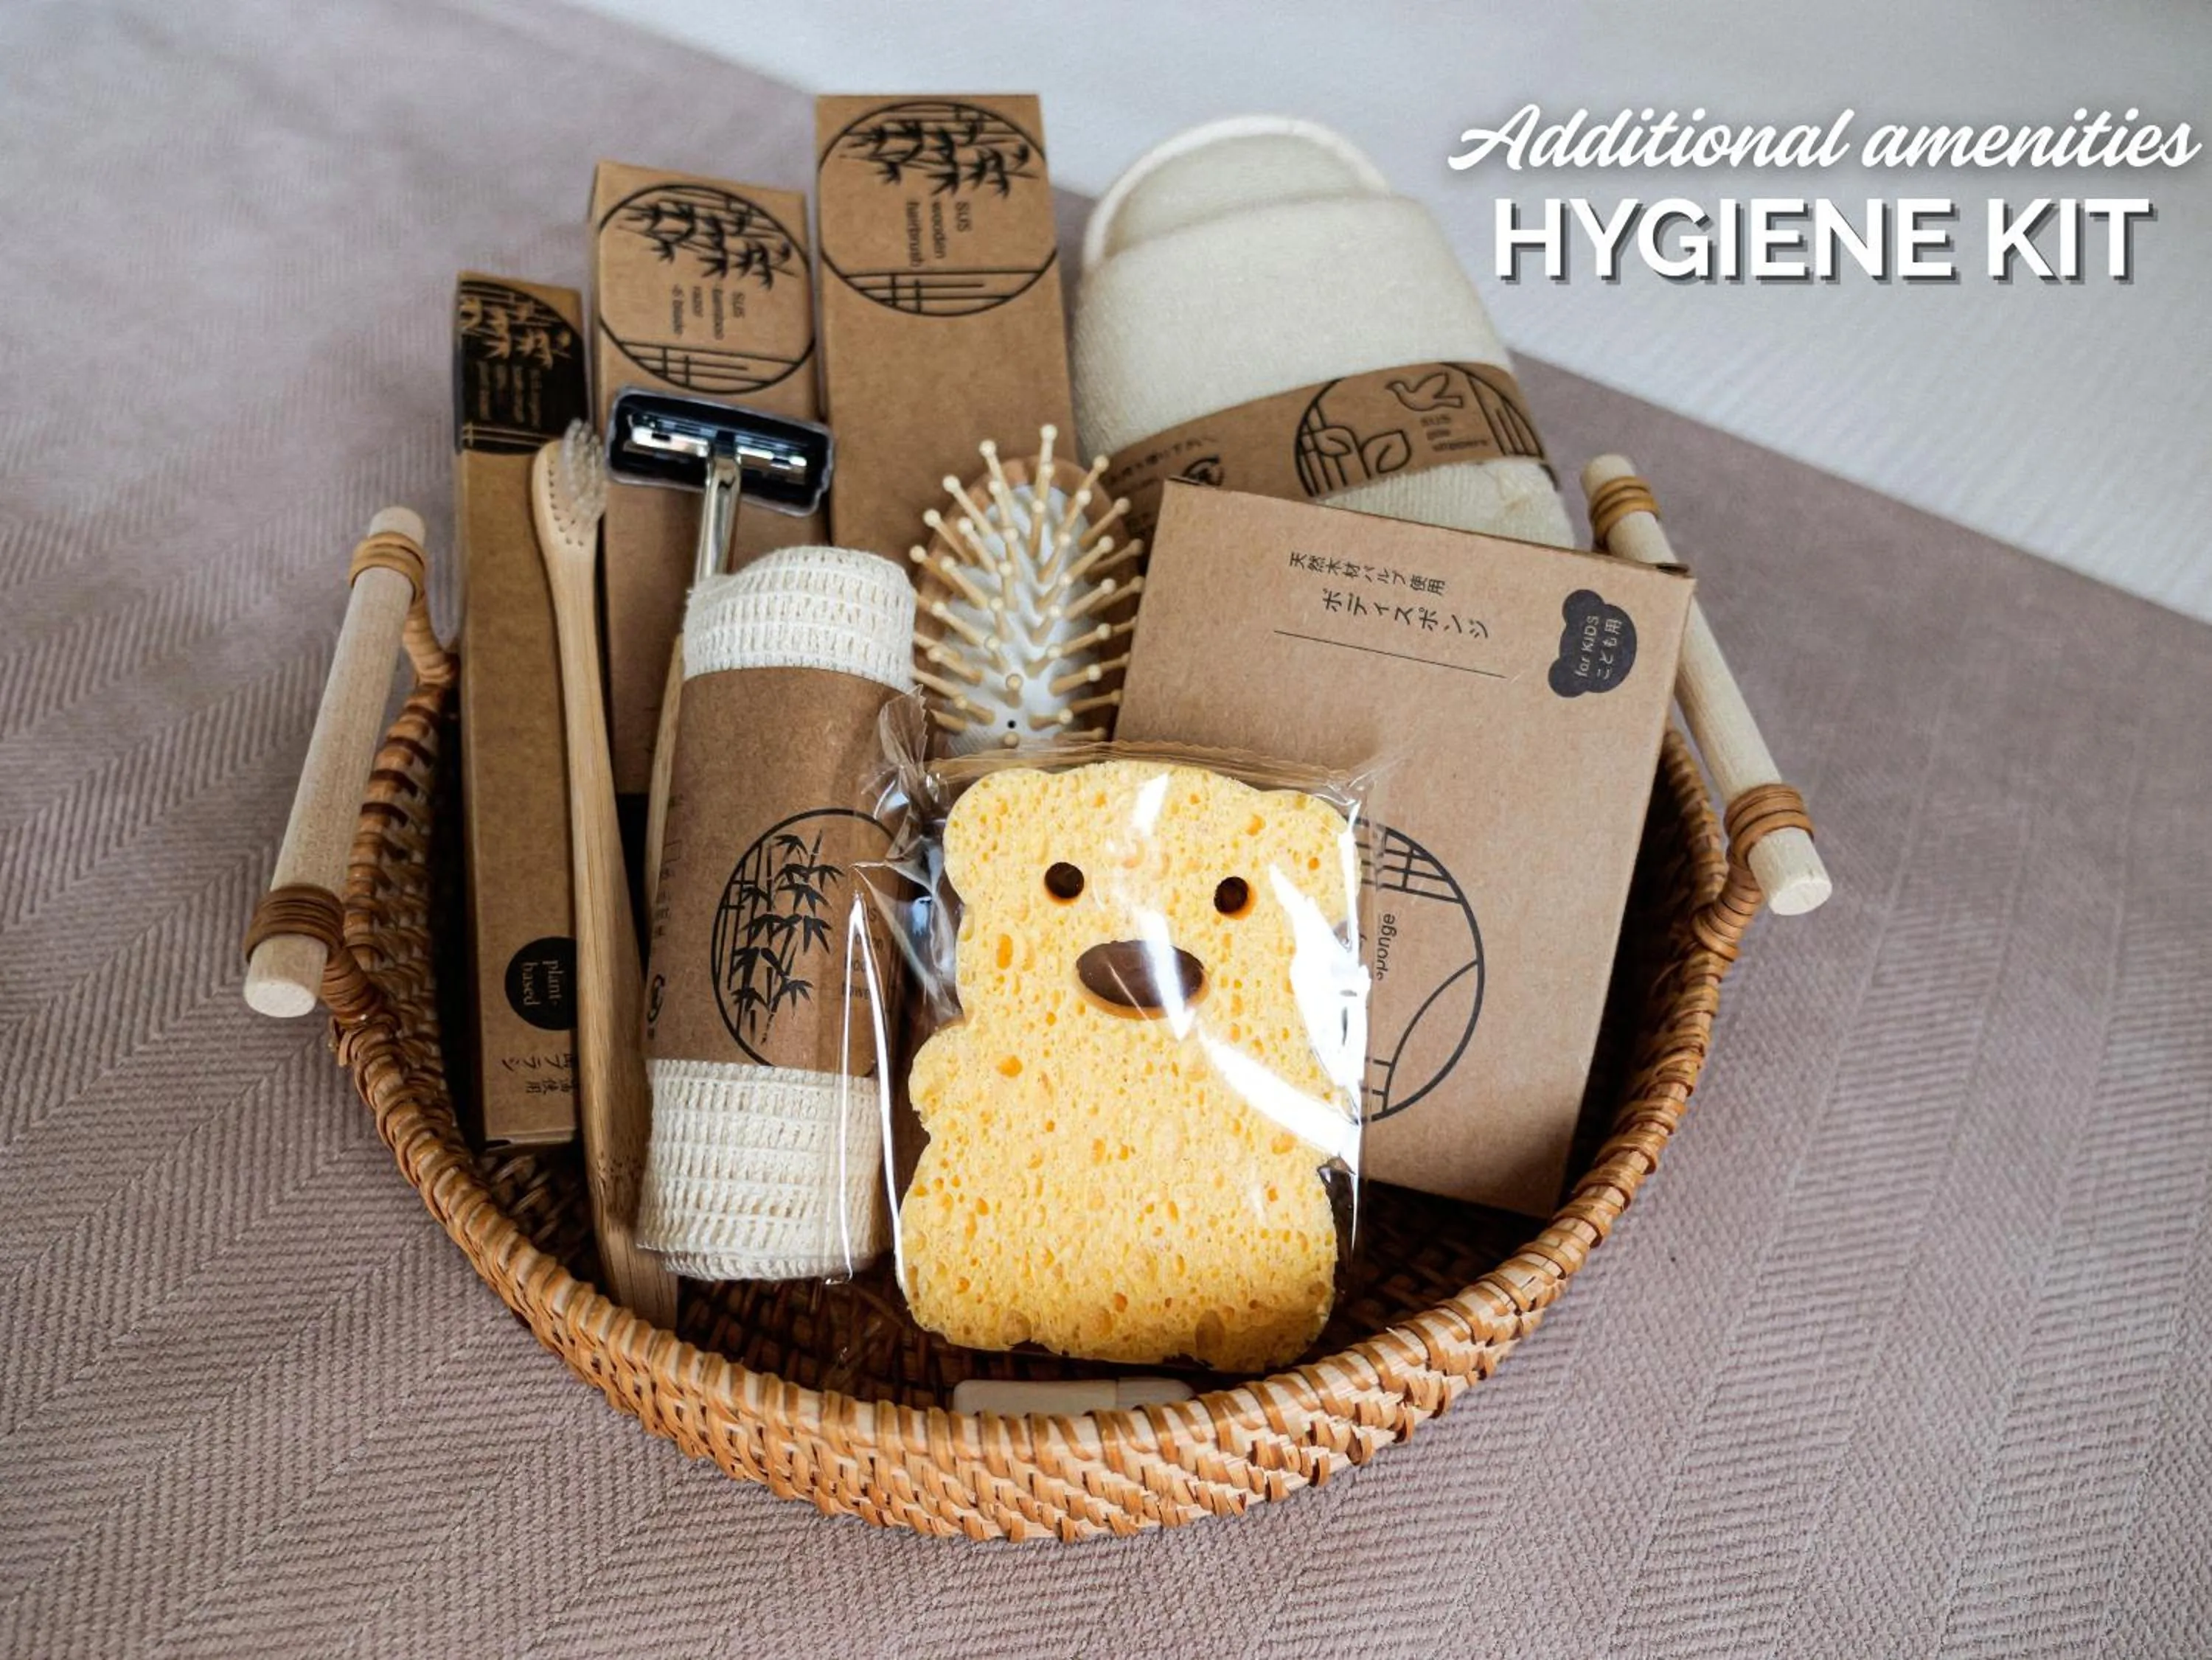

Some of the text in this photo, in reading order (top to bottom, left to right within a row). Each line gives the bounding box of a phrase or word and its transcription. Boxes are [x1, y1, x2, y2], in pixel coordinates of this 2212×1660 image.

[1289, 551, 1447, 596] 天然木材パルプ使用
[1322, 587, 1488, 639] ボディスポンジ
[1573, 615, 1600, 677] for KIDS
[1596, 618, 1622, 680] こども用
[520, 961, 540, 1005] based
